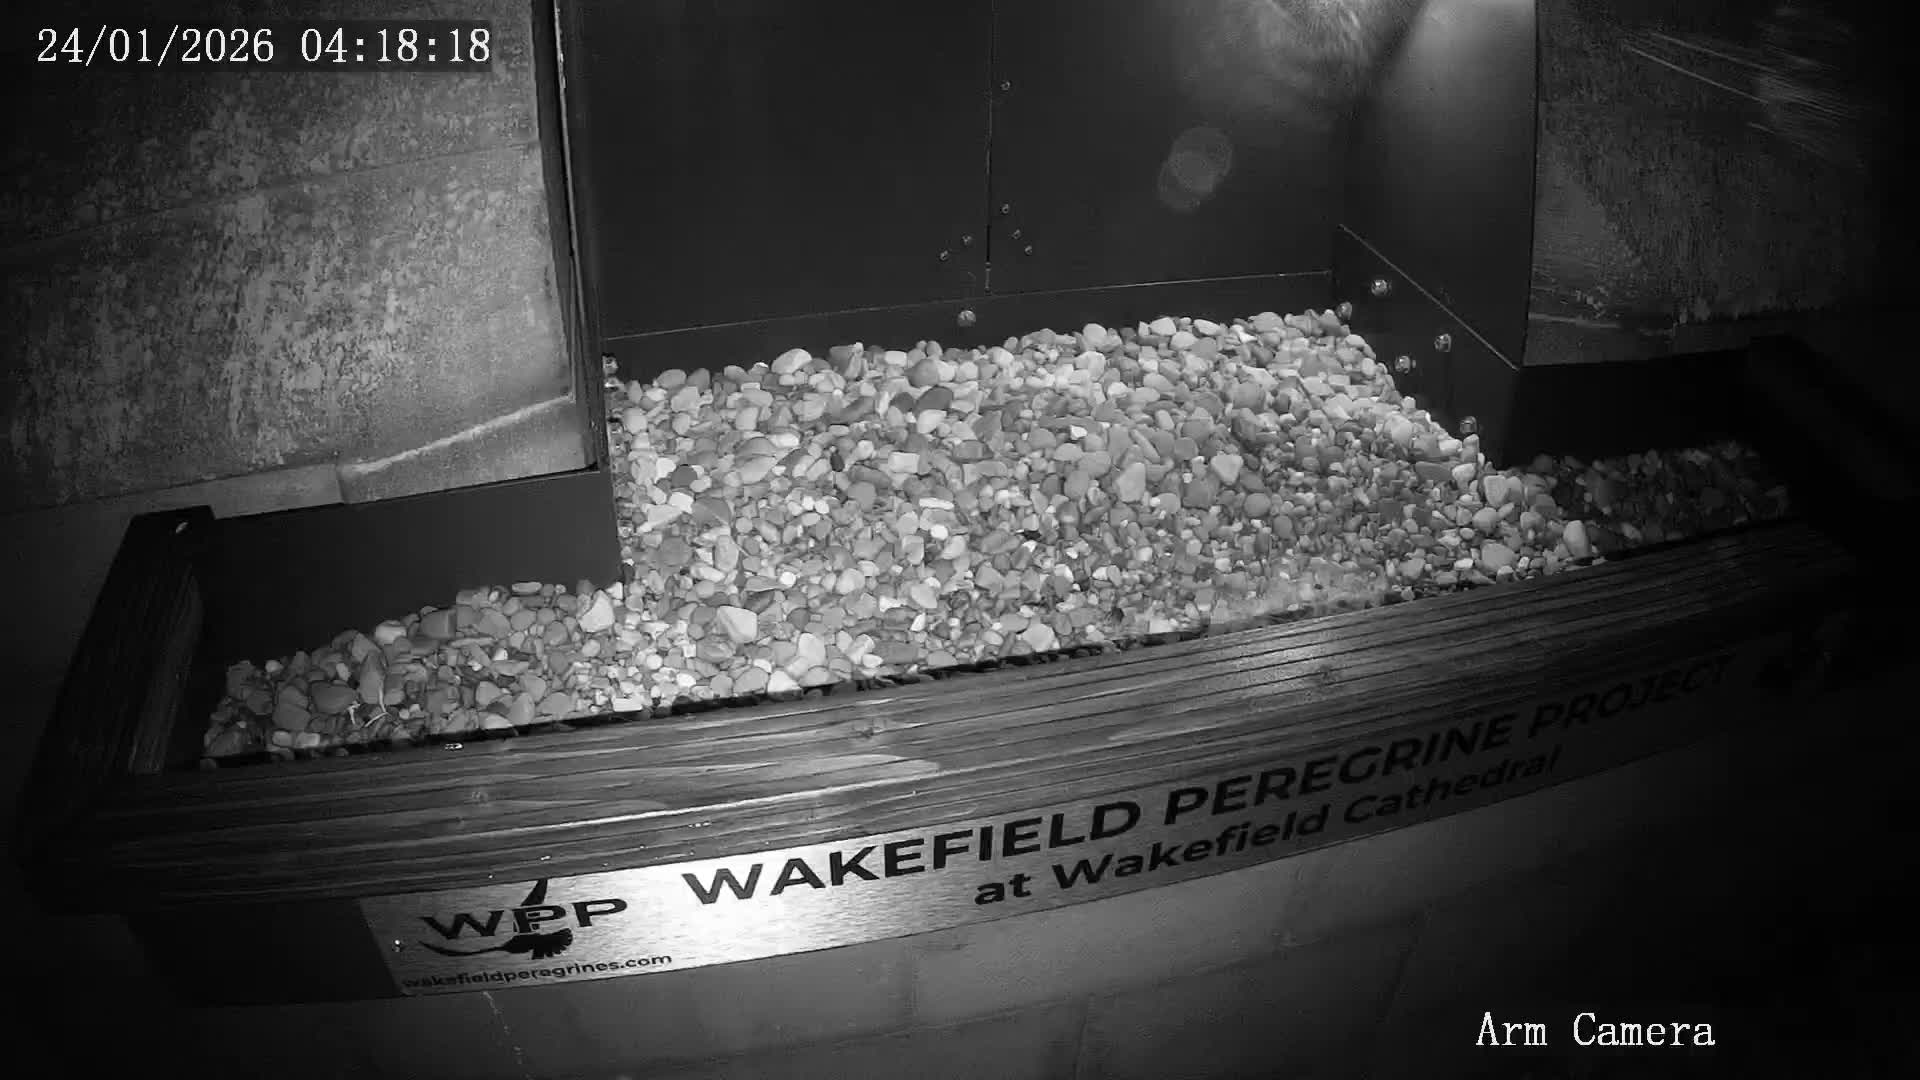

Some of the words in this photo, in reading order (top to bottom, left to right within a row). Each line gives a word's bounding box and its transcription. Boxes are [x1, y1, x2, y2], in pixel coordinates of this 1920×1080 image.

[682, 800, 1141, 904] WAKEFIELD
[1164, 713, 1513, 826] PEREGRINE
[1528, 654, 1735, 738] PROJECT
[975, 874, 1032, 905] at
[1052, 804, 1329, 889] Wakefield
[1343, 744, 1563, 825] Cathedral
[419, 898, 628, 940] WPP
[402, 952, 672, 989] wakefieldperegrines.com
